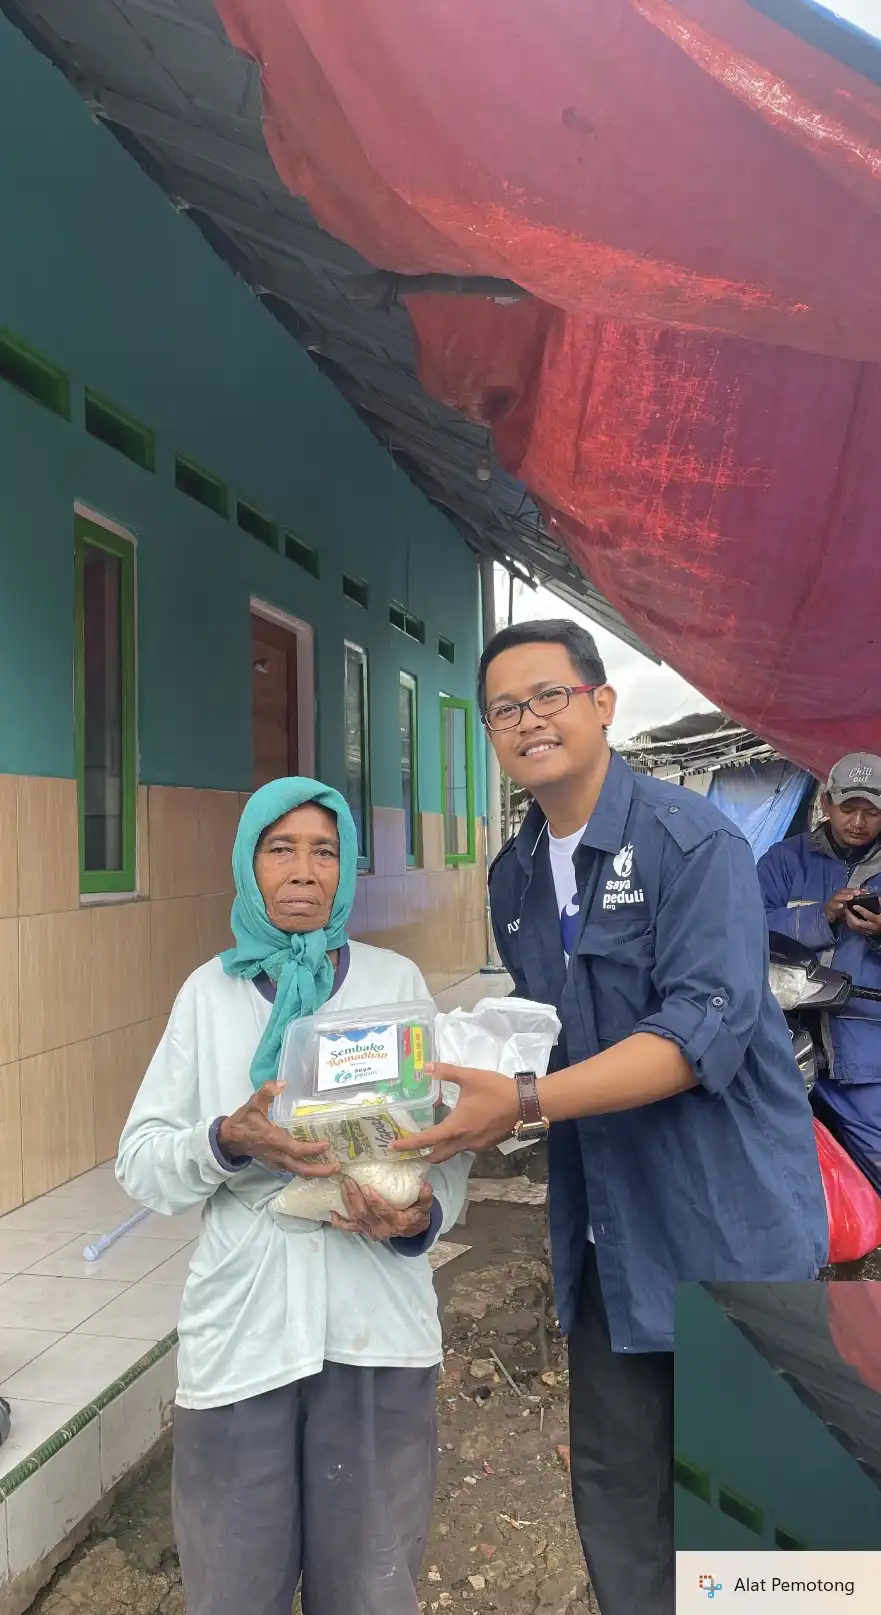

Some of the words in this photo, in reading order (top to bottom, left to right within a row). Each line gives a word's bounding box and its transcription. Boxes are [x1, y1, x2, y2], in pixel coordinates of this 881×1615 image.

[849, 767, 872, 779] Chill
[605, 879, 631, 891] saya
[603, 889, 645, 910] peduli
[507, 918, 520, 934] FU
[326, 1050, 389, 1068] Ramadhan
[330, 1042, 385, 1060] Sembako
